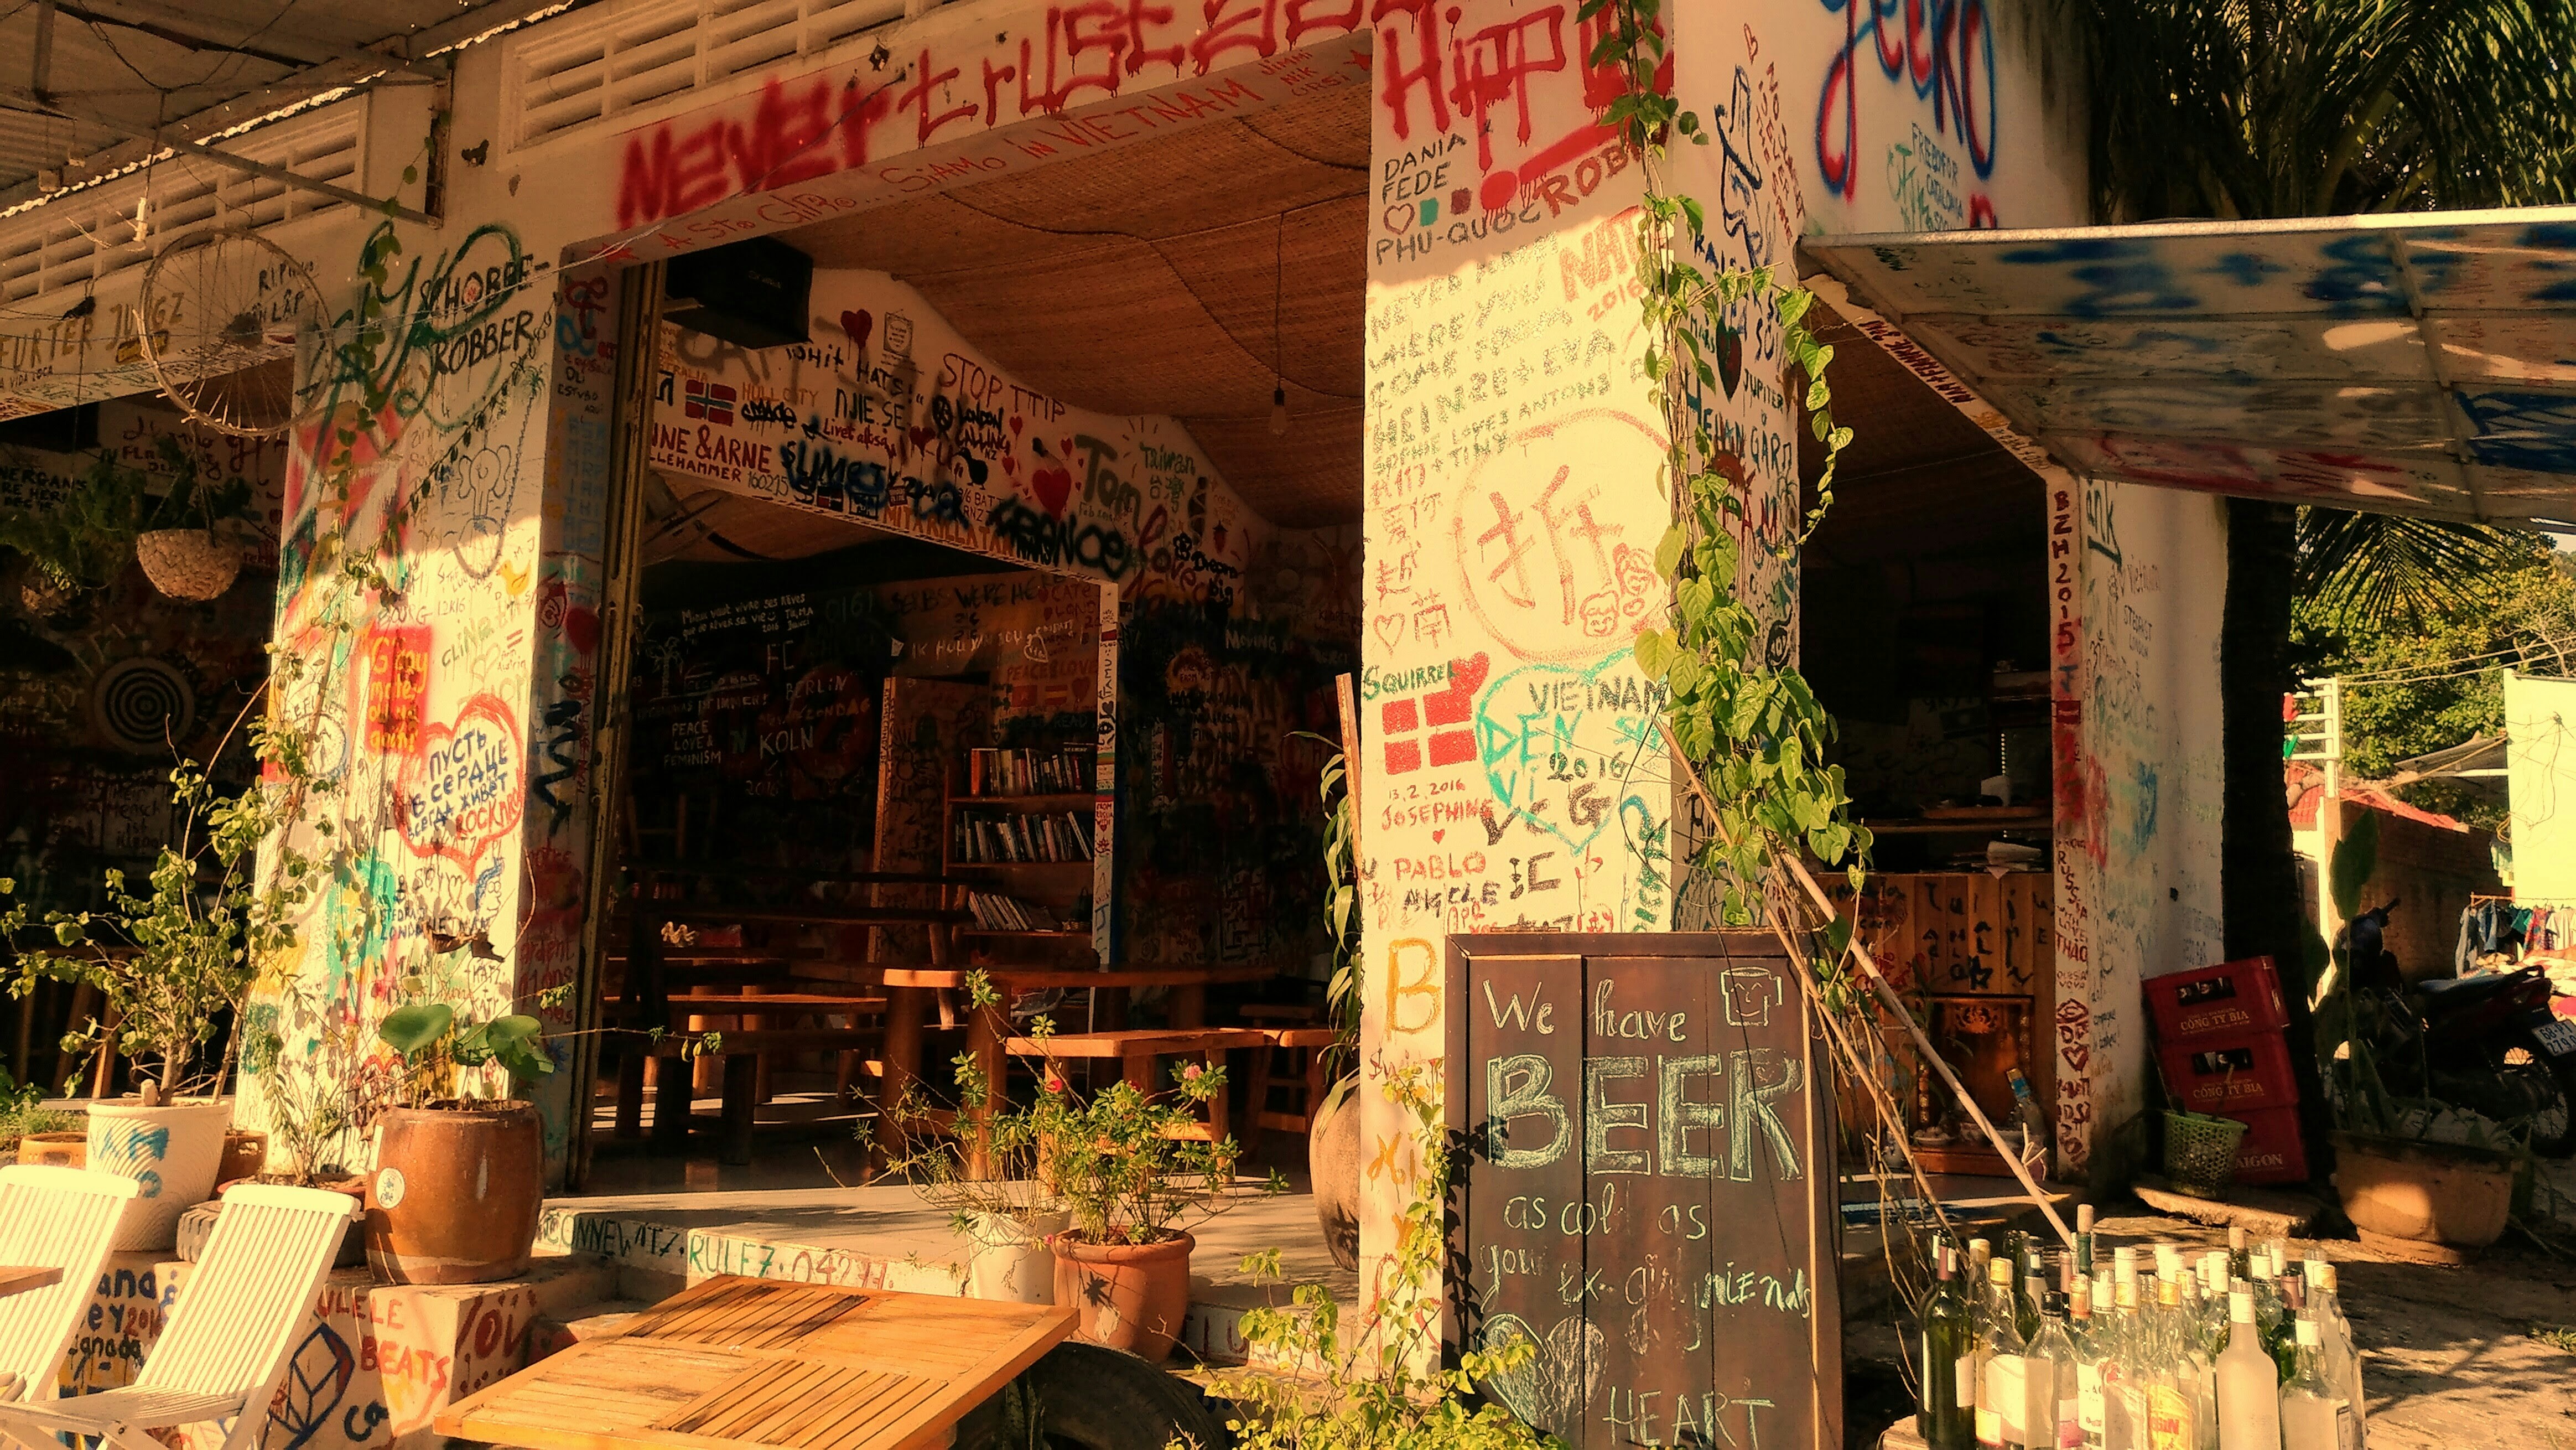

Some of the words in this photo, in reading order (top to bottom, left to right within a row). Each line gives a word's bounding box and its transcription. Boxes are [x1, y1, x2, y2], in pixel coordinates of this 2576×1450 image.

[1036, 77, 1265, 147] VIETNAM
[1384, 132, 1467, 183] DANIA
[1382, 161, 1451, 205] FEDE
[1377, 203, 1541, 266] PHU-QUOC
[1586, 276, 1645, 323] 2016
[943, 352, 1003, 407] STOP
[1010, 384, 1066, 423] TTIP
[1140, 441, 1196, 475] Taiwan
[1528, 675, 1671, 712] VIETNAM
[672, 719, 709, 737] PEACE
[674, 736, 705, 752] LOVE
[663, 750, 722, 769] FEMINISM
[1394, 850, 1487, 882] PABLO
[1483, 979, 1555, 1035] We
[1591, 978, 1687, 1042] have
[1486, 1048, 1805, 1183] BEER
[1503, 1195, 1548, 1230] as
[1657, 1203, 1707, 1240] as
[360, 1334, 450, 1391] BEATS
[1603, 1385, 1775, 1450] HEART
